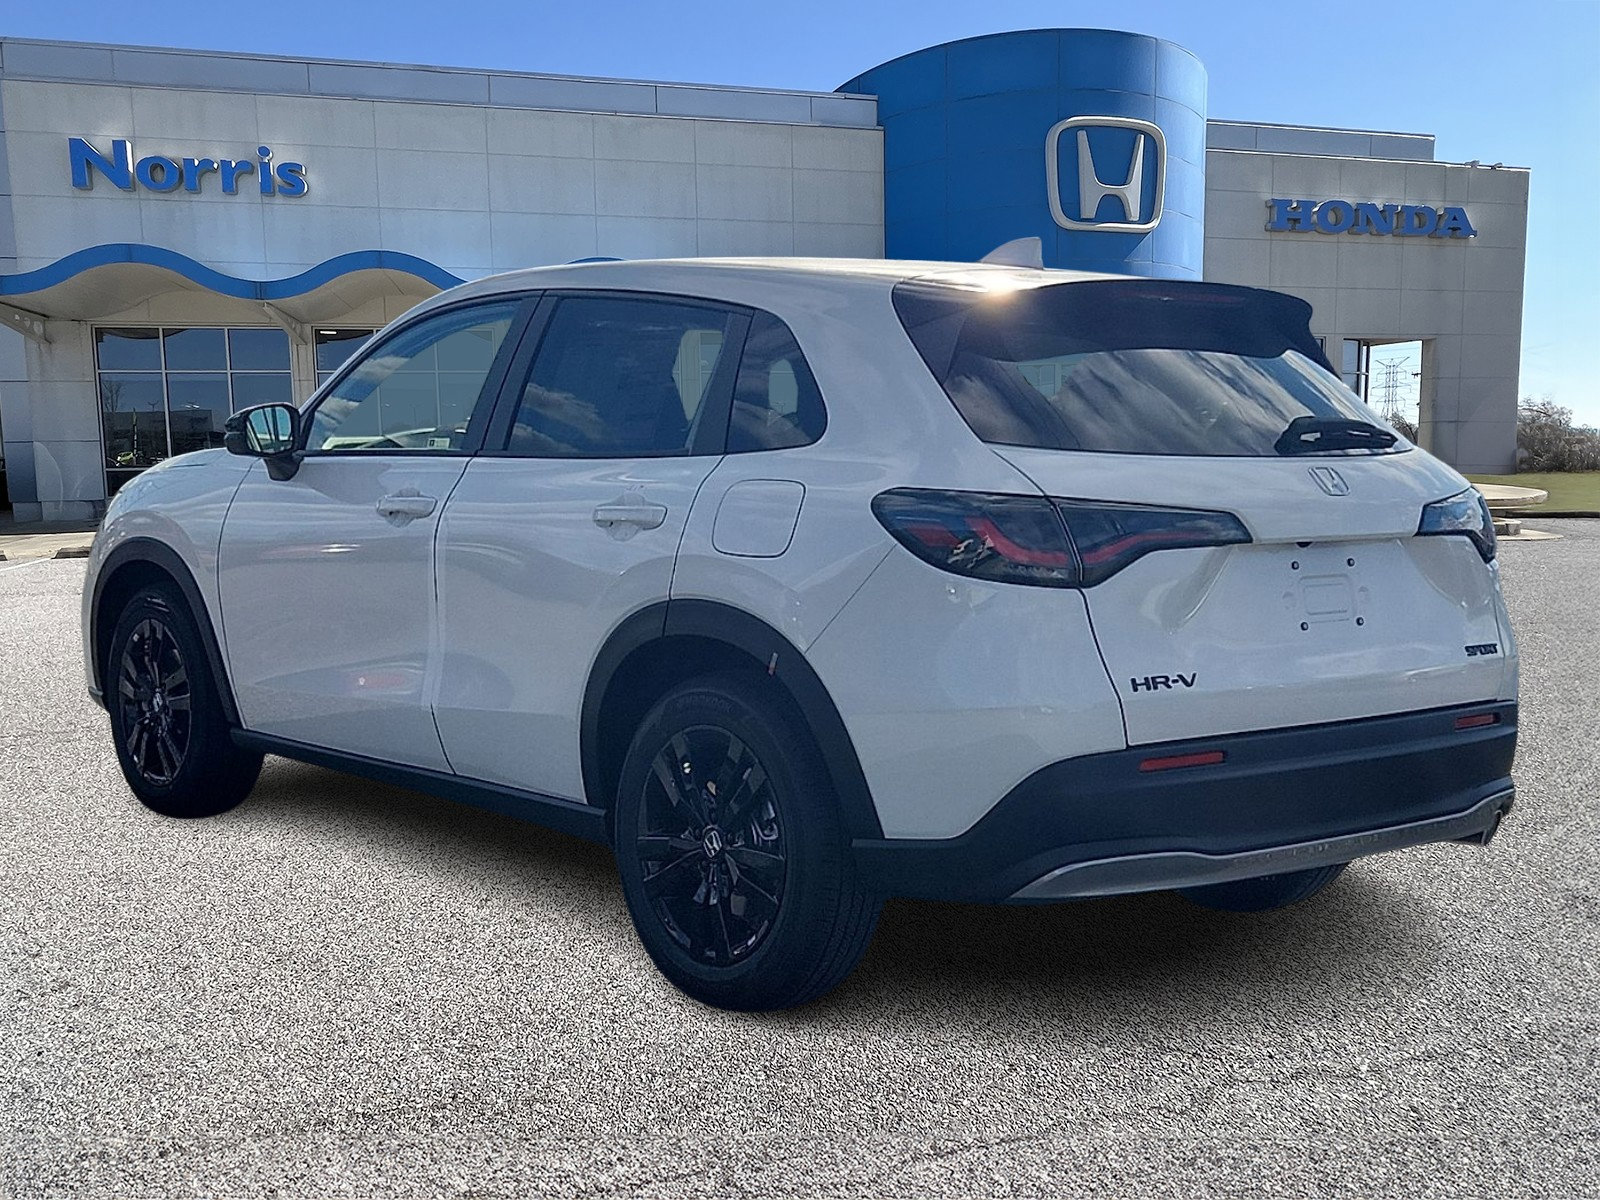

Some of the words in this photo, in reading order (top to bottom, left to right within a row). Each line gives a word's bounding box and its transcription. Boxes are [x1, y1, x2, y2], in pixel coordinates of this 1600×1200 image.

[68, 137, 309, 197] Norris
[1265, 198, 1478, 240] HONDA
[1130, 672, 1197, 693] HR-V
